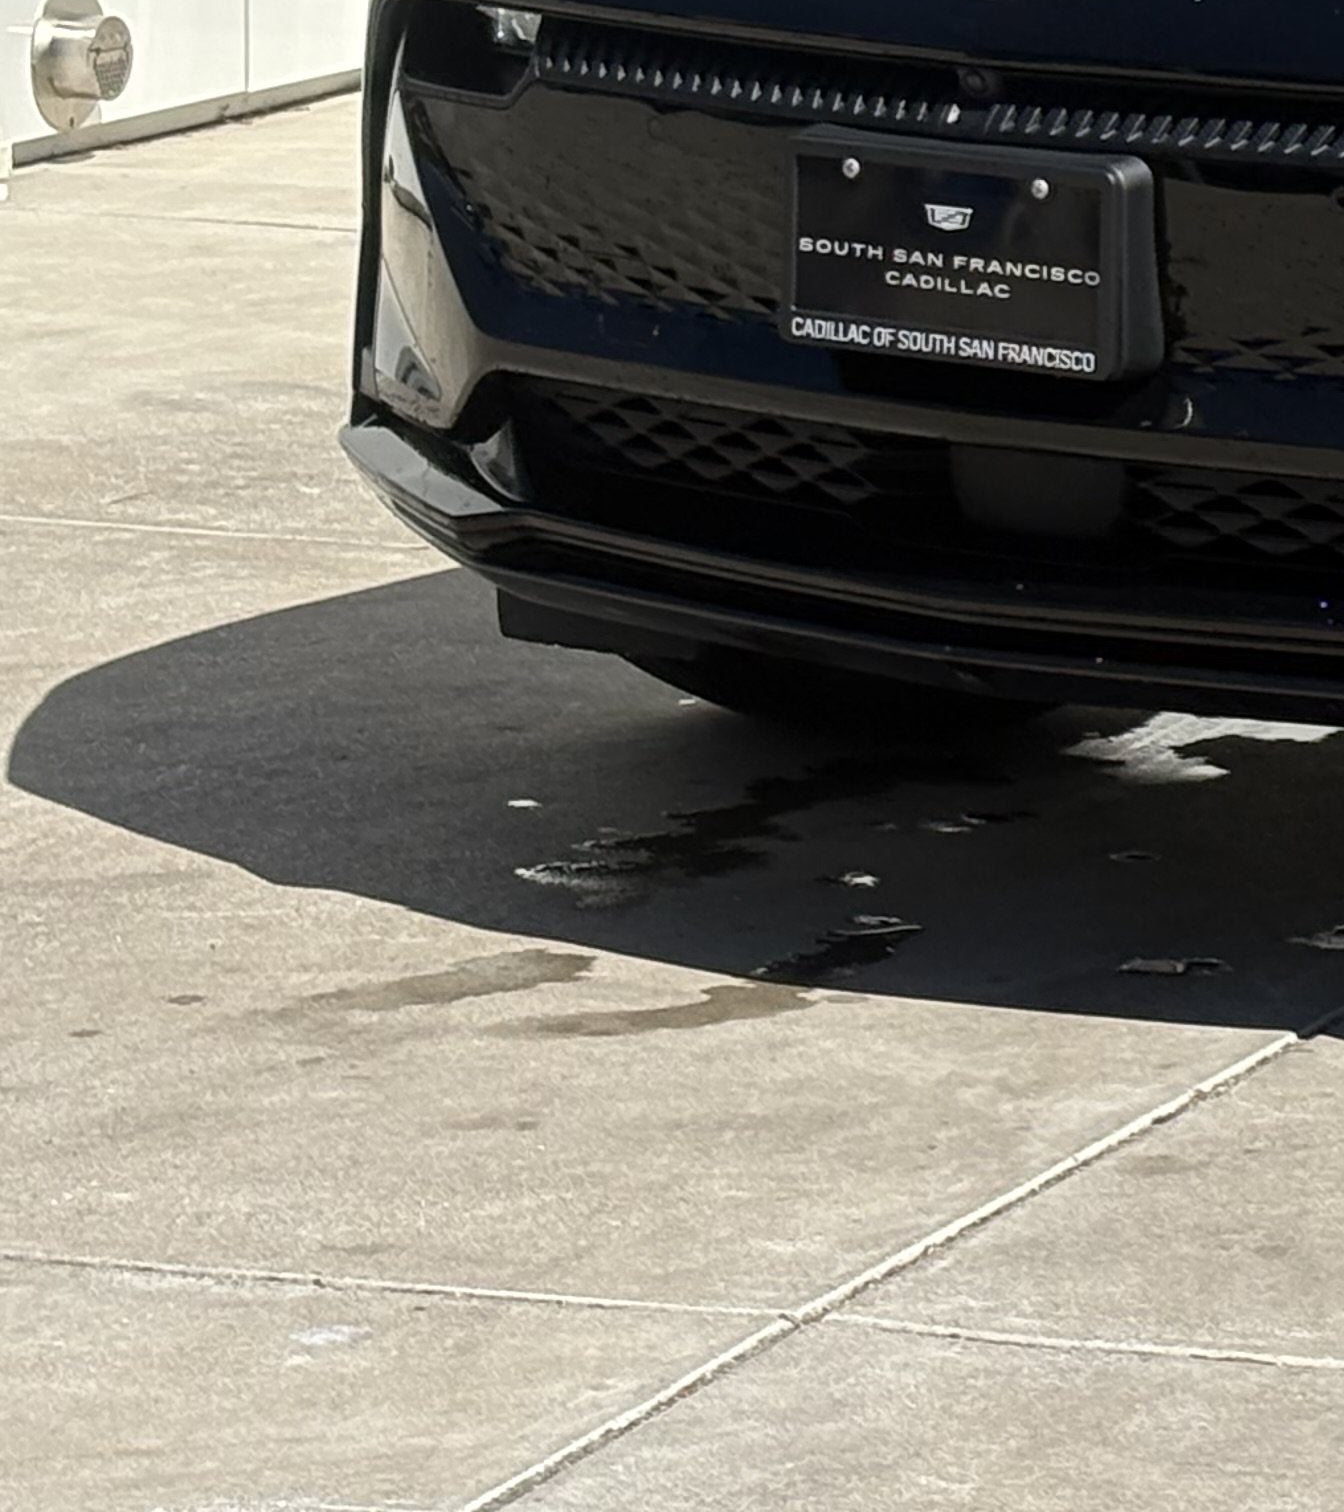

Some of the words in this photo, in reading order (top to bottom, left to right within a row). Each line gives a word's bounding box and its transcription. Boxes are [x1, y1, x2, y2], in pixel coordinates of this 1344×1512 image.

[798, 236, 884, 262] SOUTH
[893, 247, 943, 268] SAN
[952, 255, 1101, 287] FRANCISCO
[885, 270, 1012, 299] CADILLAC
[791, 316, 872, 347] CADILLAC
[873, 326, 897, 349] OF
[897, 329, 956, 357] SOUTH
[959, 336, 995, 362] SAN
[998, 342, 1096, 373] FRANCISCO
